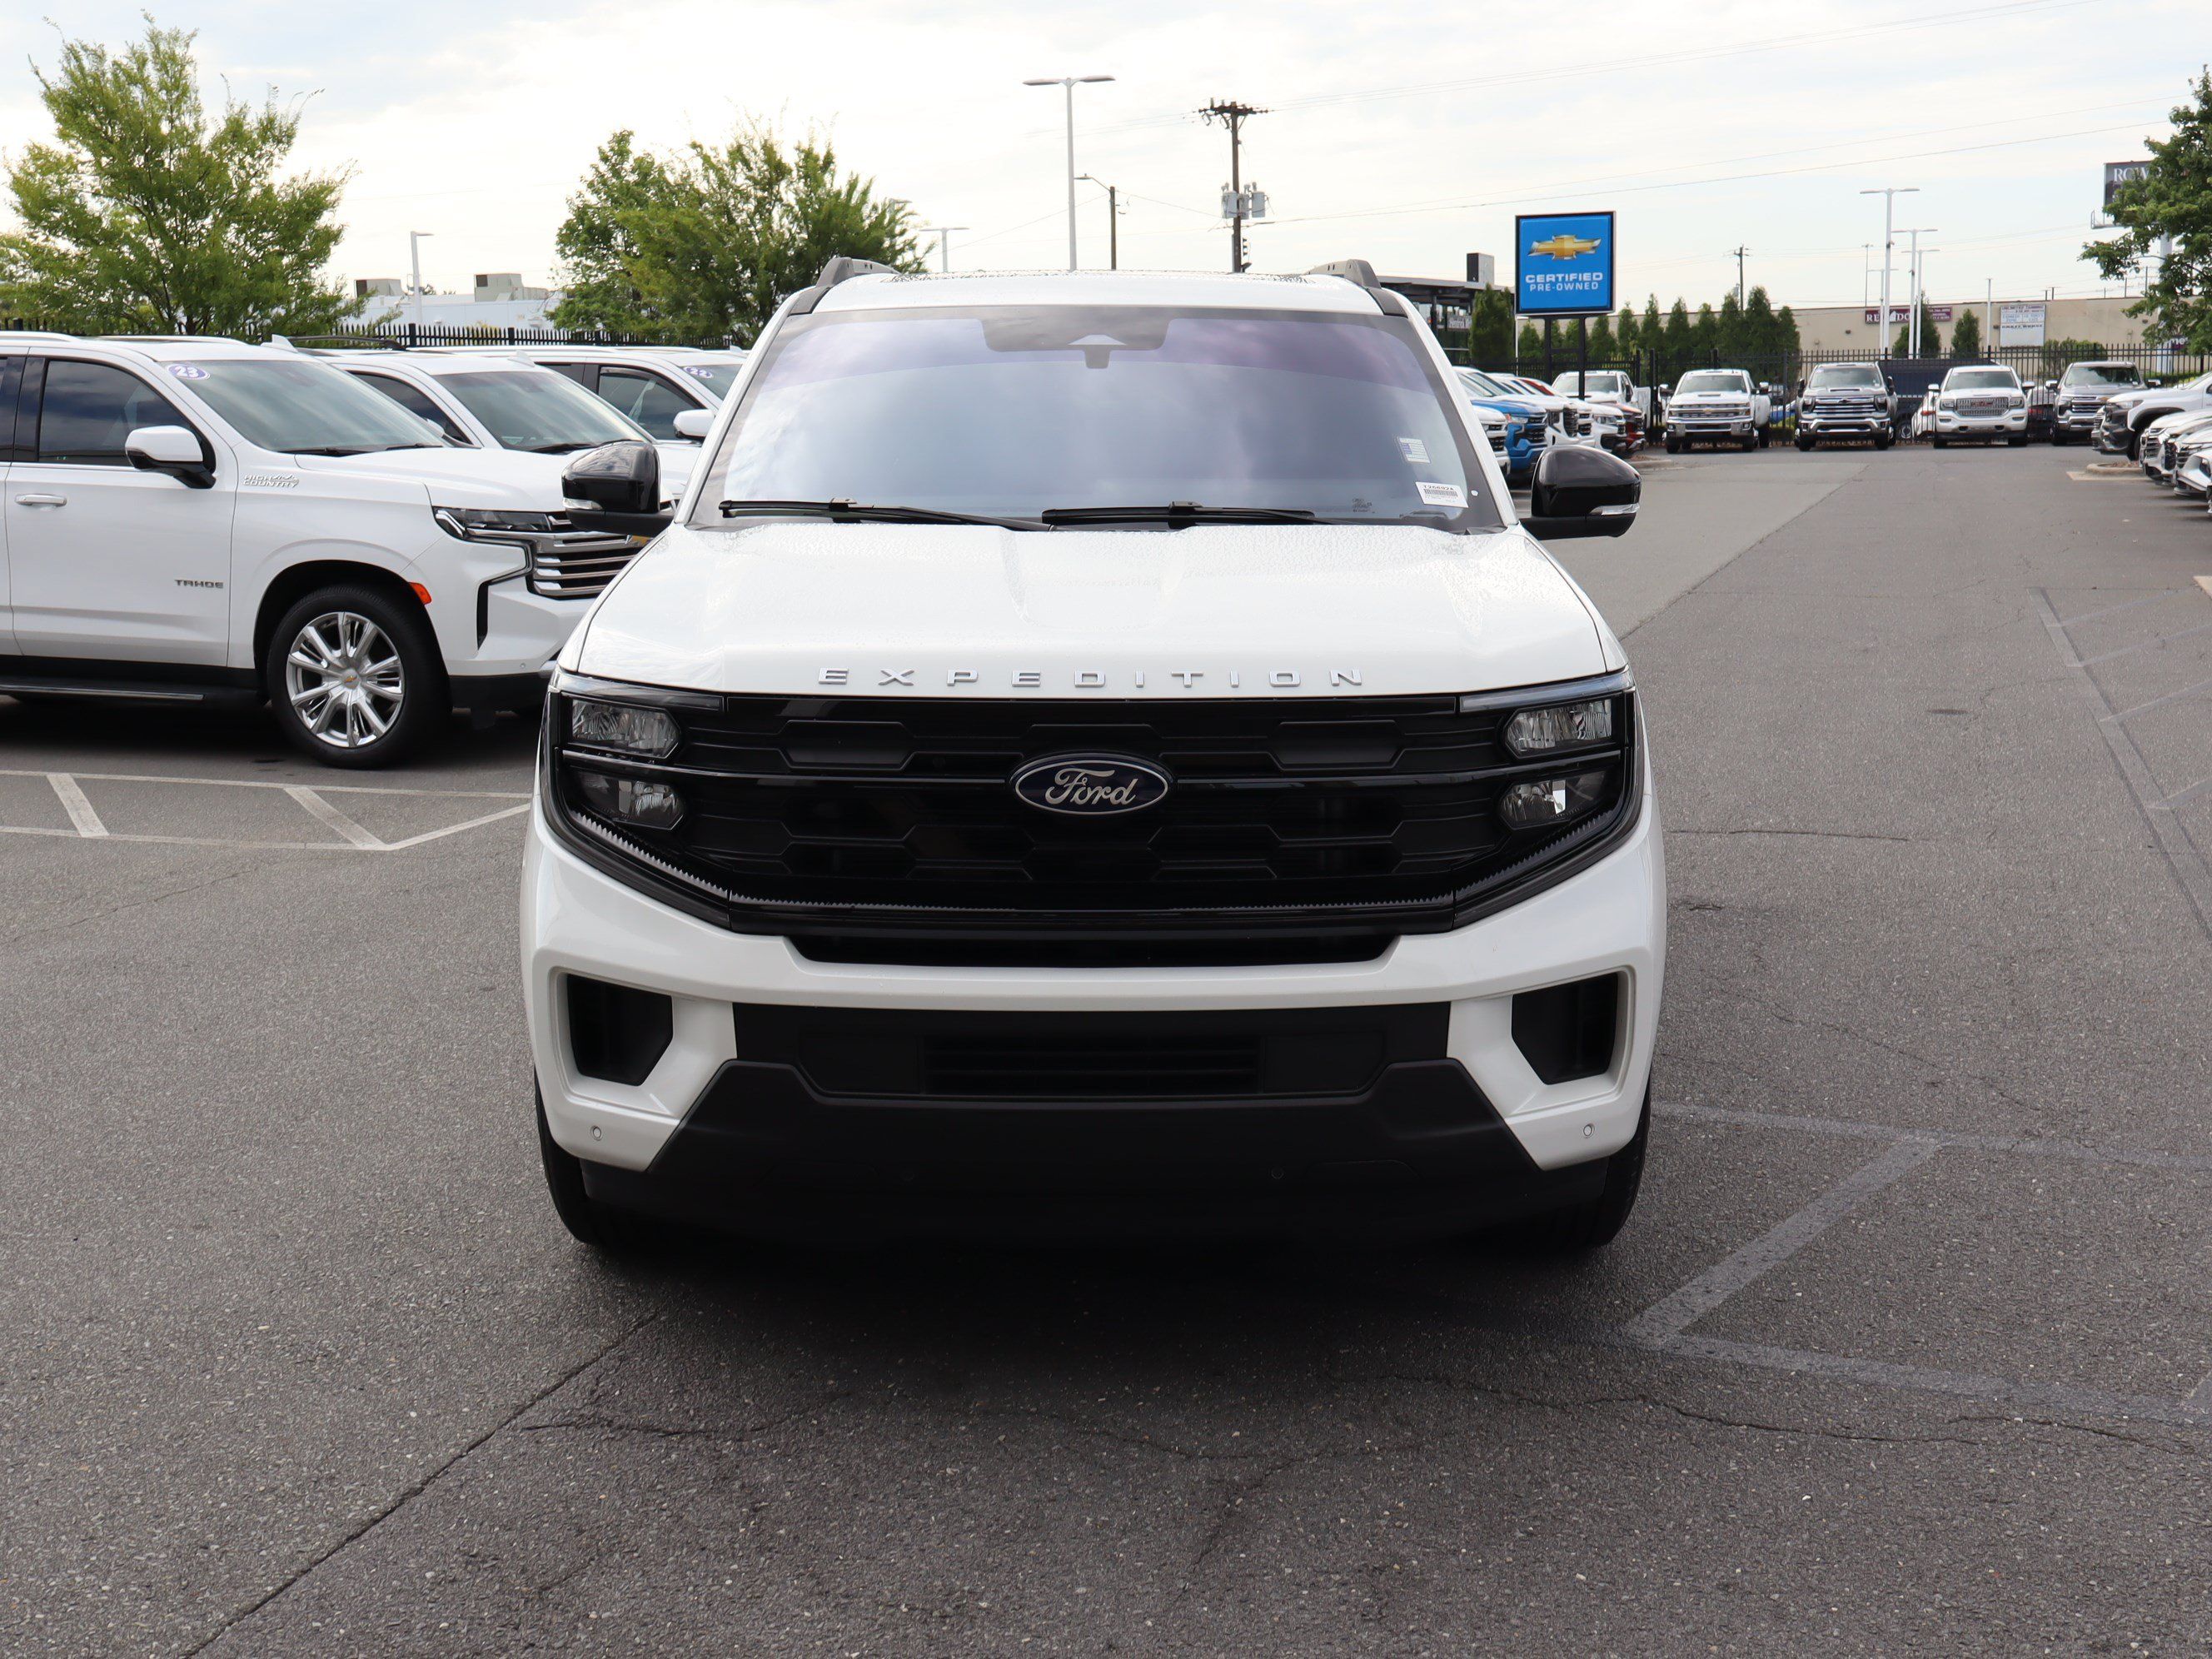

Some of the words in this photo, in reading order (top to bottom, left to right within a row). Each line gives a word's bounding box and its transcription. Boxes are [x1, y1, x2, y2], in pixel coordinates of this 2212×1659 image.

[1525, 272, 1603, 283] CERTIFIED
[1530, 281, 1598, 291] PRE-OWNED
[174, 366, 199, 378] 23
[690, 367, 707, 378] 22
[174, 579, 224, 589] TAHOE
[818, 667, 1363, 688] EXPEDITION
[1044, 766, 1138, 806] Ford
